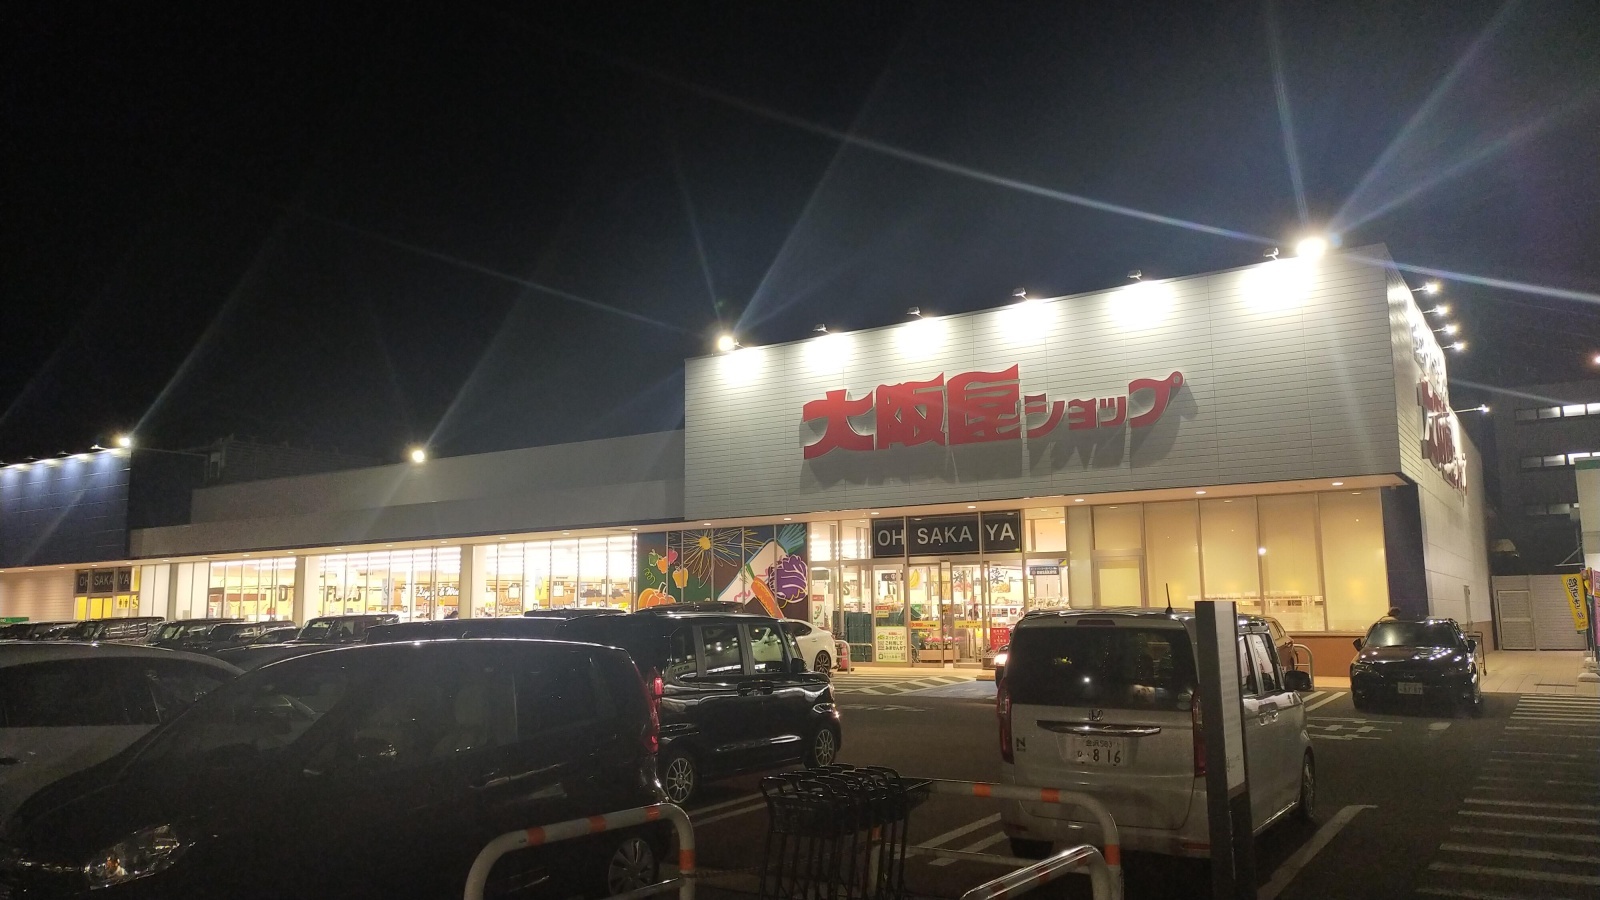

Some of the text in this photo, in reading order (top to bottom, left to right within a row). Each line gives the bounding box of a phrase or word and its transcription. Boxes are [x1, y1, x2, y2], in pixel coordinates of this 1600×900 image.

[803, 363, 1184, 460] 大阪屋ショップ
[877, 522, 1016, 547] OH SAKA YA
[94, 574, 114, 586] SAKA
[119, 573, 129, 584] YA
